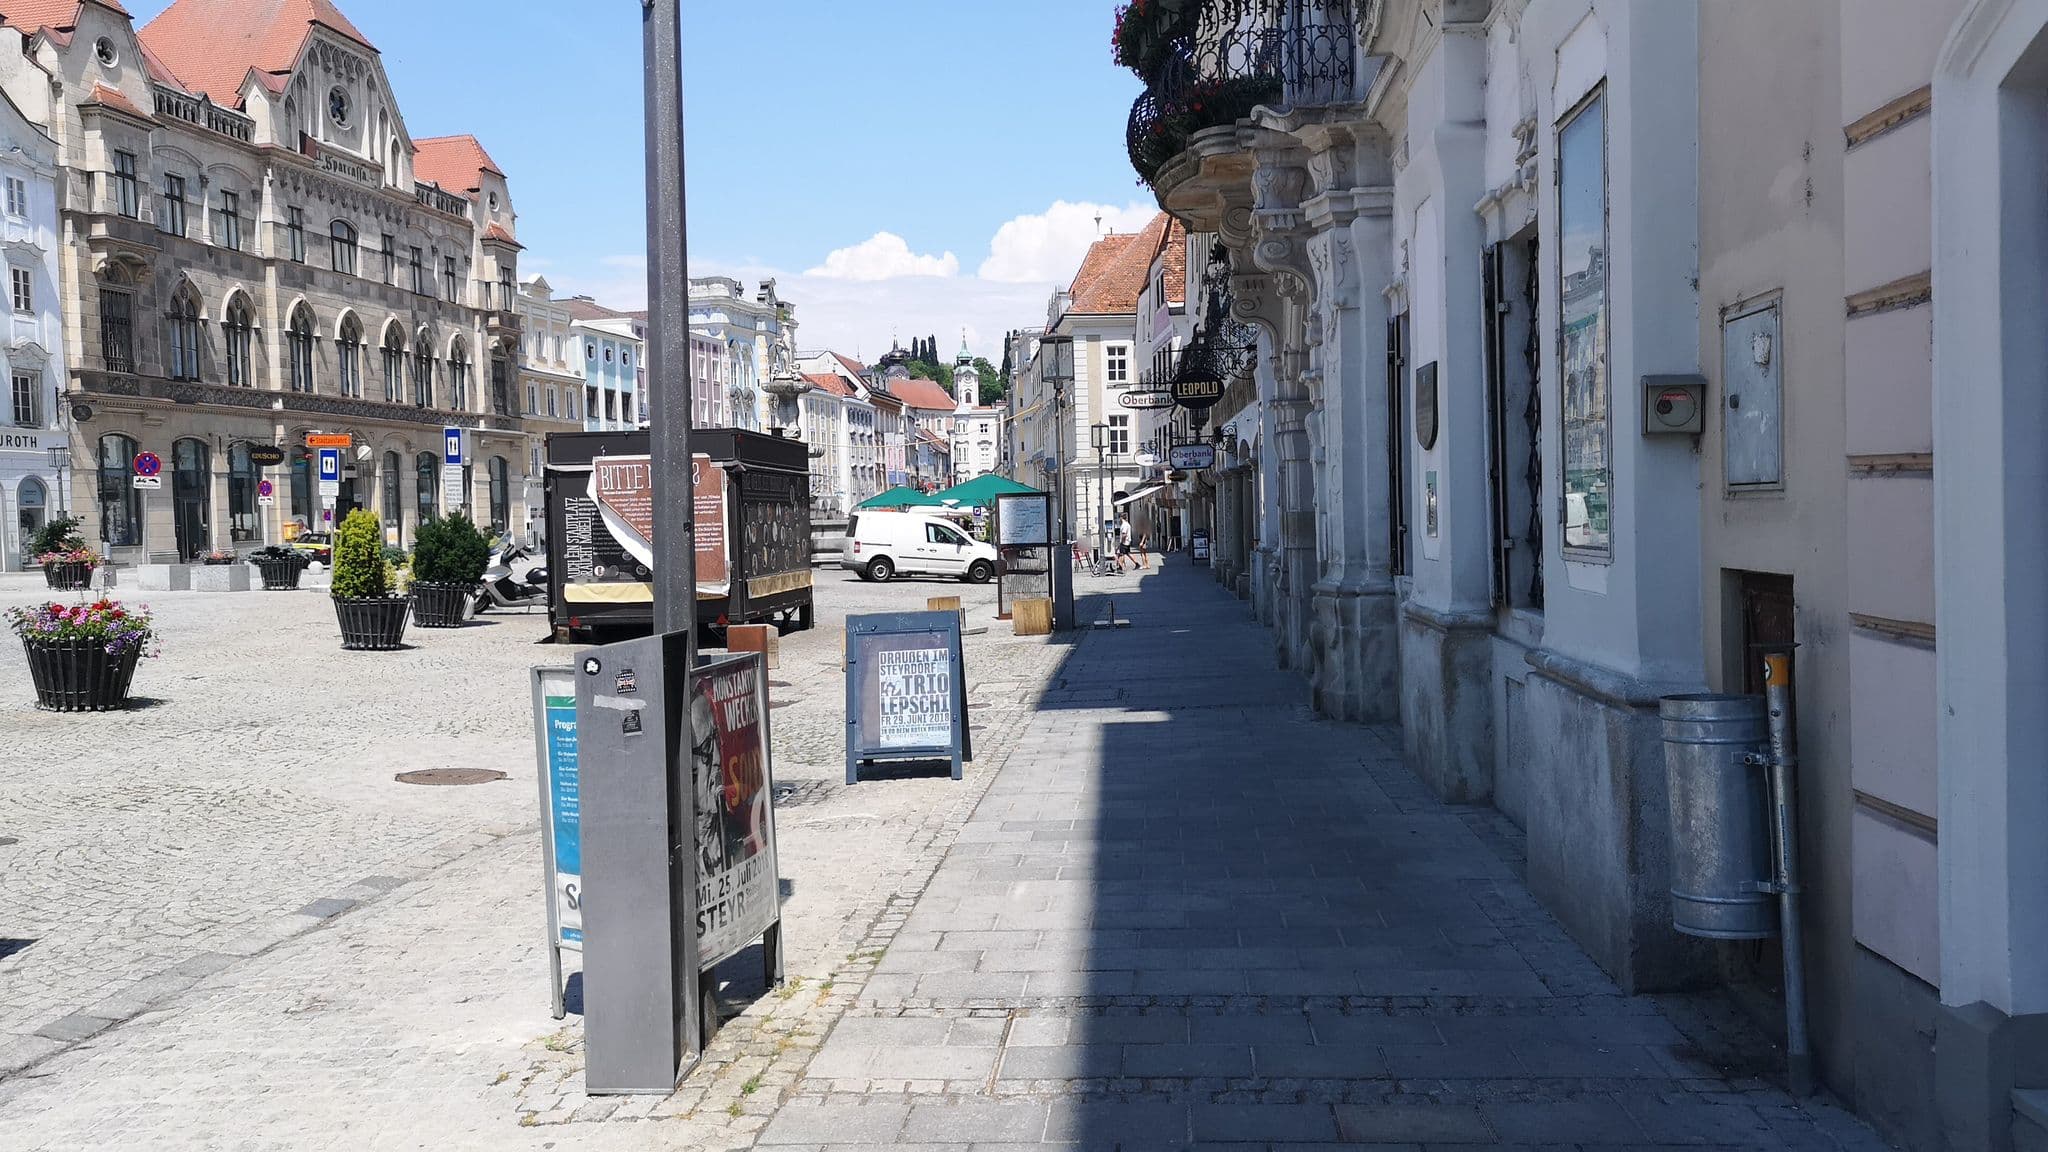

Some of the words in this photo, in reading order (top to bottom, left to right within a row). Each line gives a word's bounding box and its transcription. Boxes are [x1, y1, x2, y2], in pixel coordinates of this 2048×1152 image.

[1176, 381, 1218, 396] LEOPOLD
[1122, 394, 1174, 405] Oberbank
[1171, 449, 1212, 459] Oberbank
[599, 464, 644, 490] BITTE
[564, 497, 580, 544] STADTPLATZ
[932, 650, 948, 662] IM
[880, 662, 936, 676] STEYRDORF
[902, 672, 949, 696] TRIO
[880, 694, 949, 716] LEPSCHI
[881, 716, 891, 726] FR
[929, 712, 950, 723] 2018
[719, 874, 734, 899] 25.
[737, 860, 752, 889] Juli
[696, 890, 746, 939] STEYR
